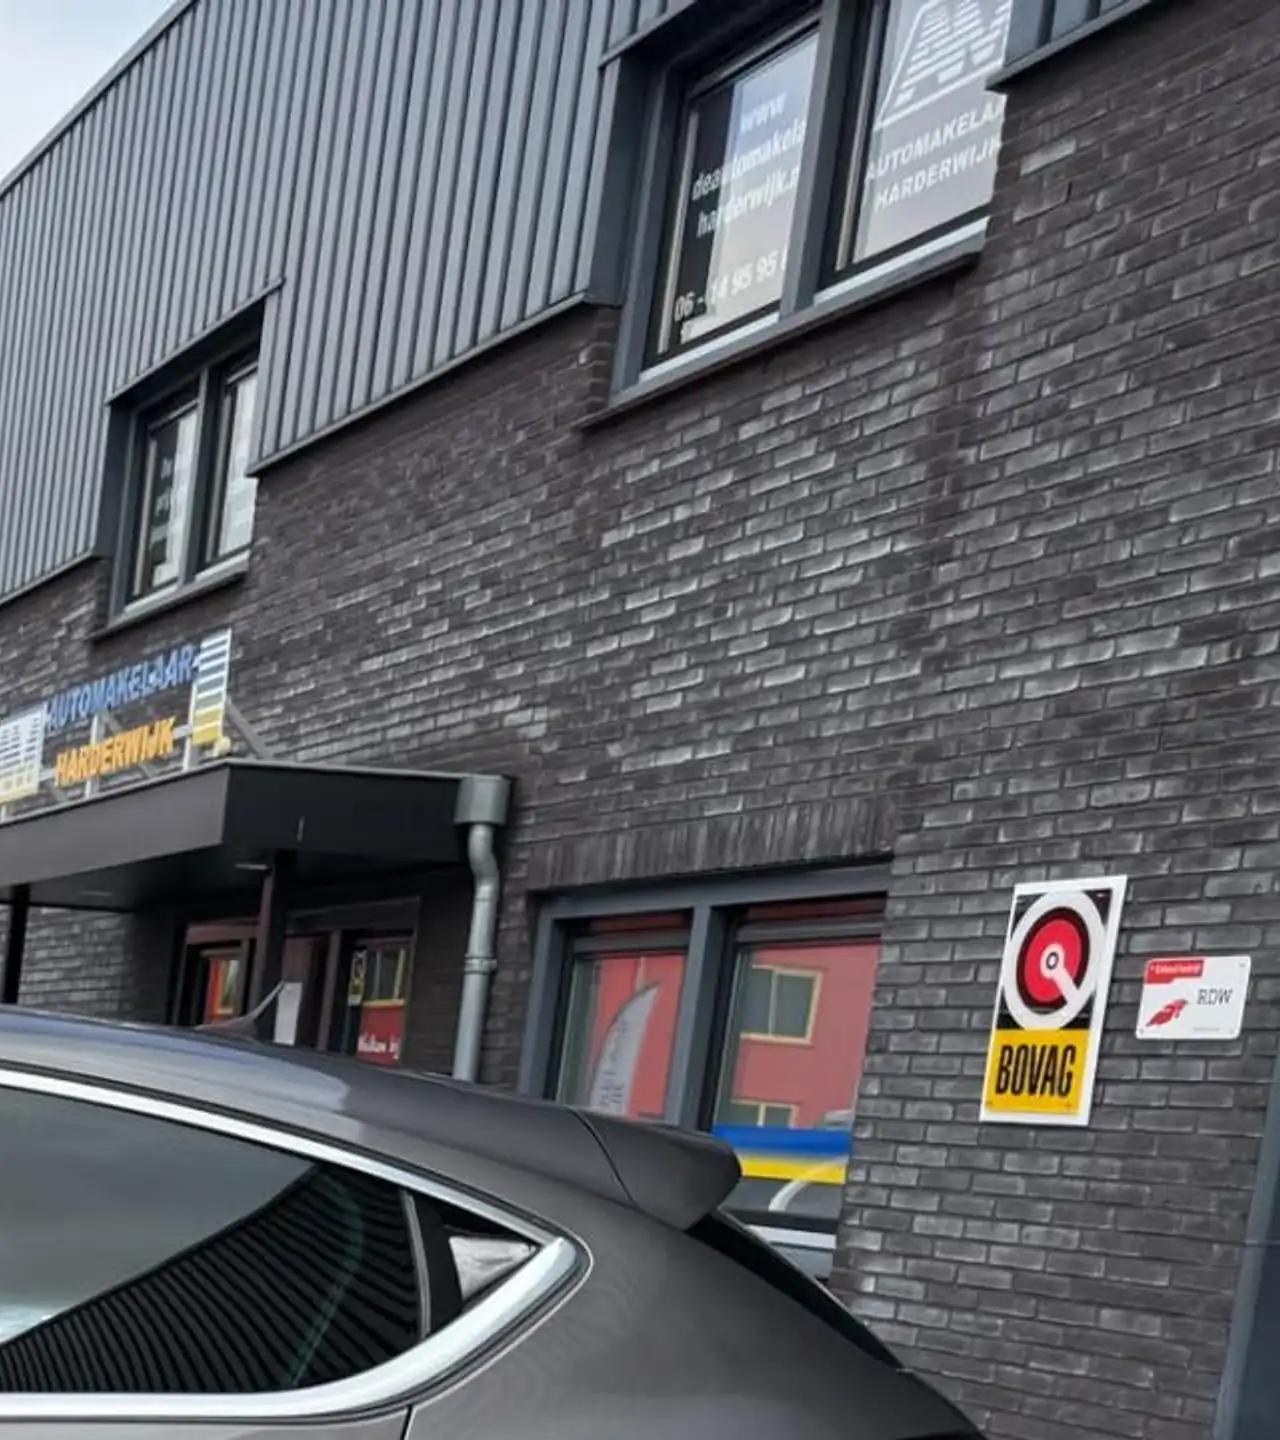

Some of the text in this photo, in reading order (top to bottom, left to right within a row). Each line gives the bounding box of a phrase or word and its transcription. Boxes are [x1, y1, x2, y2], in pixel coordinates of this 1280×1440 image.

[674, 291, 695, 322] 06
[46, 645, 195, 731] AUTOMAKELAAR
[54, 716, 176, 787] HARDERWIJK
[995, 1044, 1077, 1096] BOVAG
